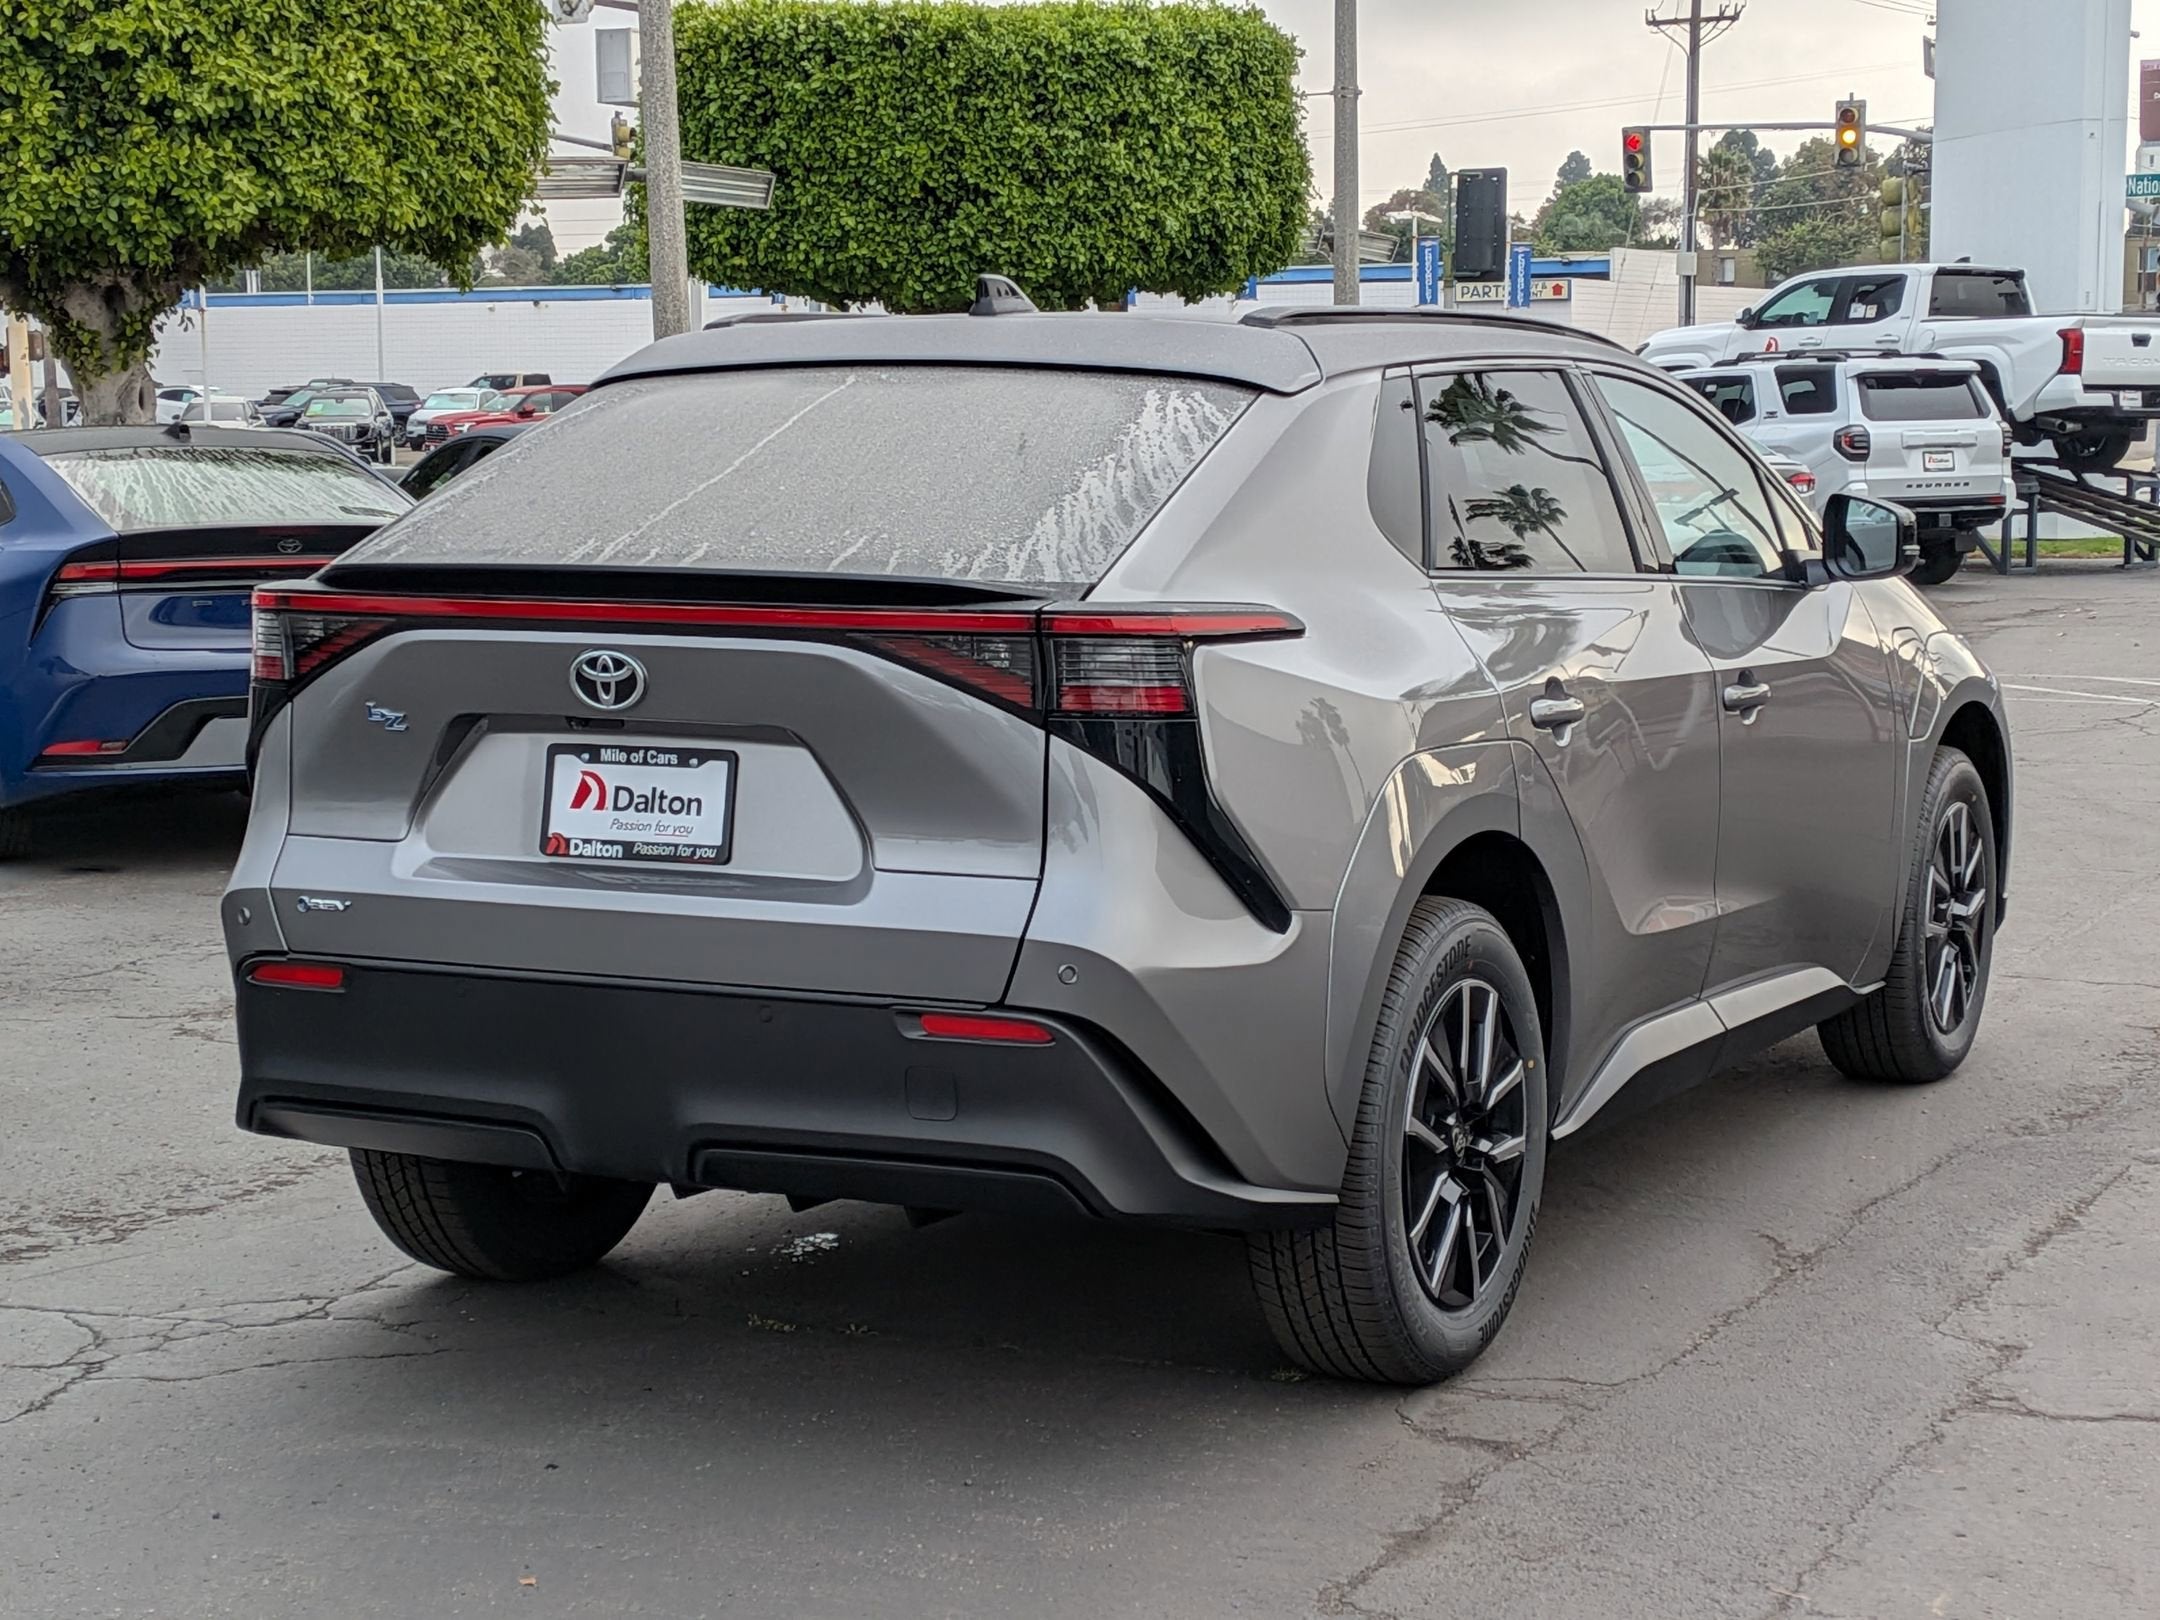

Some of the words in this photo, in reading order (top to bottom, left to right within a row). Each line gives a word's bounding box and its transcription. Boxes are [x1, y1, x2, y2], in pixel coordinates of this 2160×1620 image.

[2128, 177, 2160, 195] Natio
[600, 749, 626, 763] Mile
[630, 750, 644, 764] of
[647, 750, 678, 765] Cars
[612, 785, 702, 816] Dalton
[610, 818, 652, 831] Passion
[654, 820, 670, 833] for
[672, 825, 693, 835] you
[569, 839, 623, 858] Dalton
[632, 842, 675, 857] Passion
[676, 844, 693, 858] for
[693, 847, 717, 860] you
